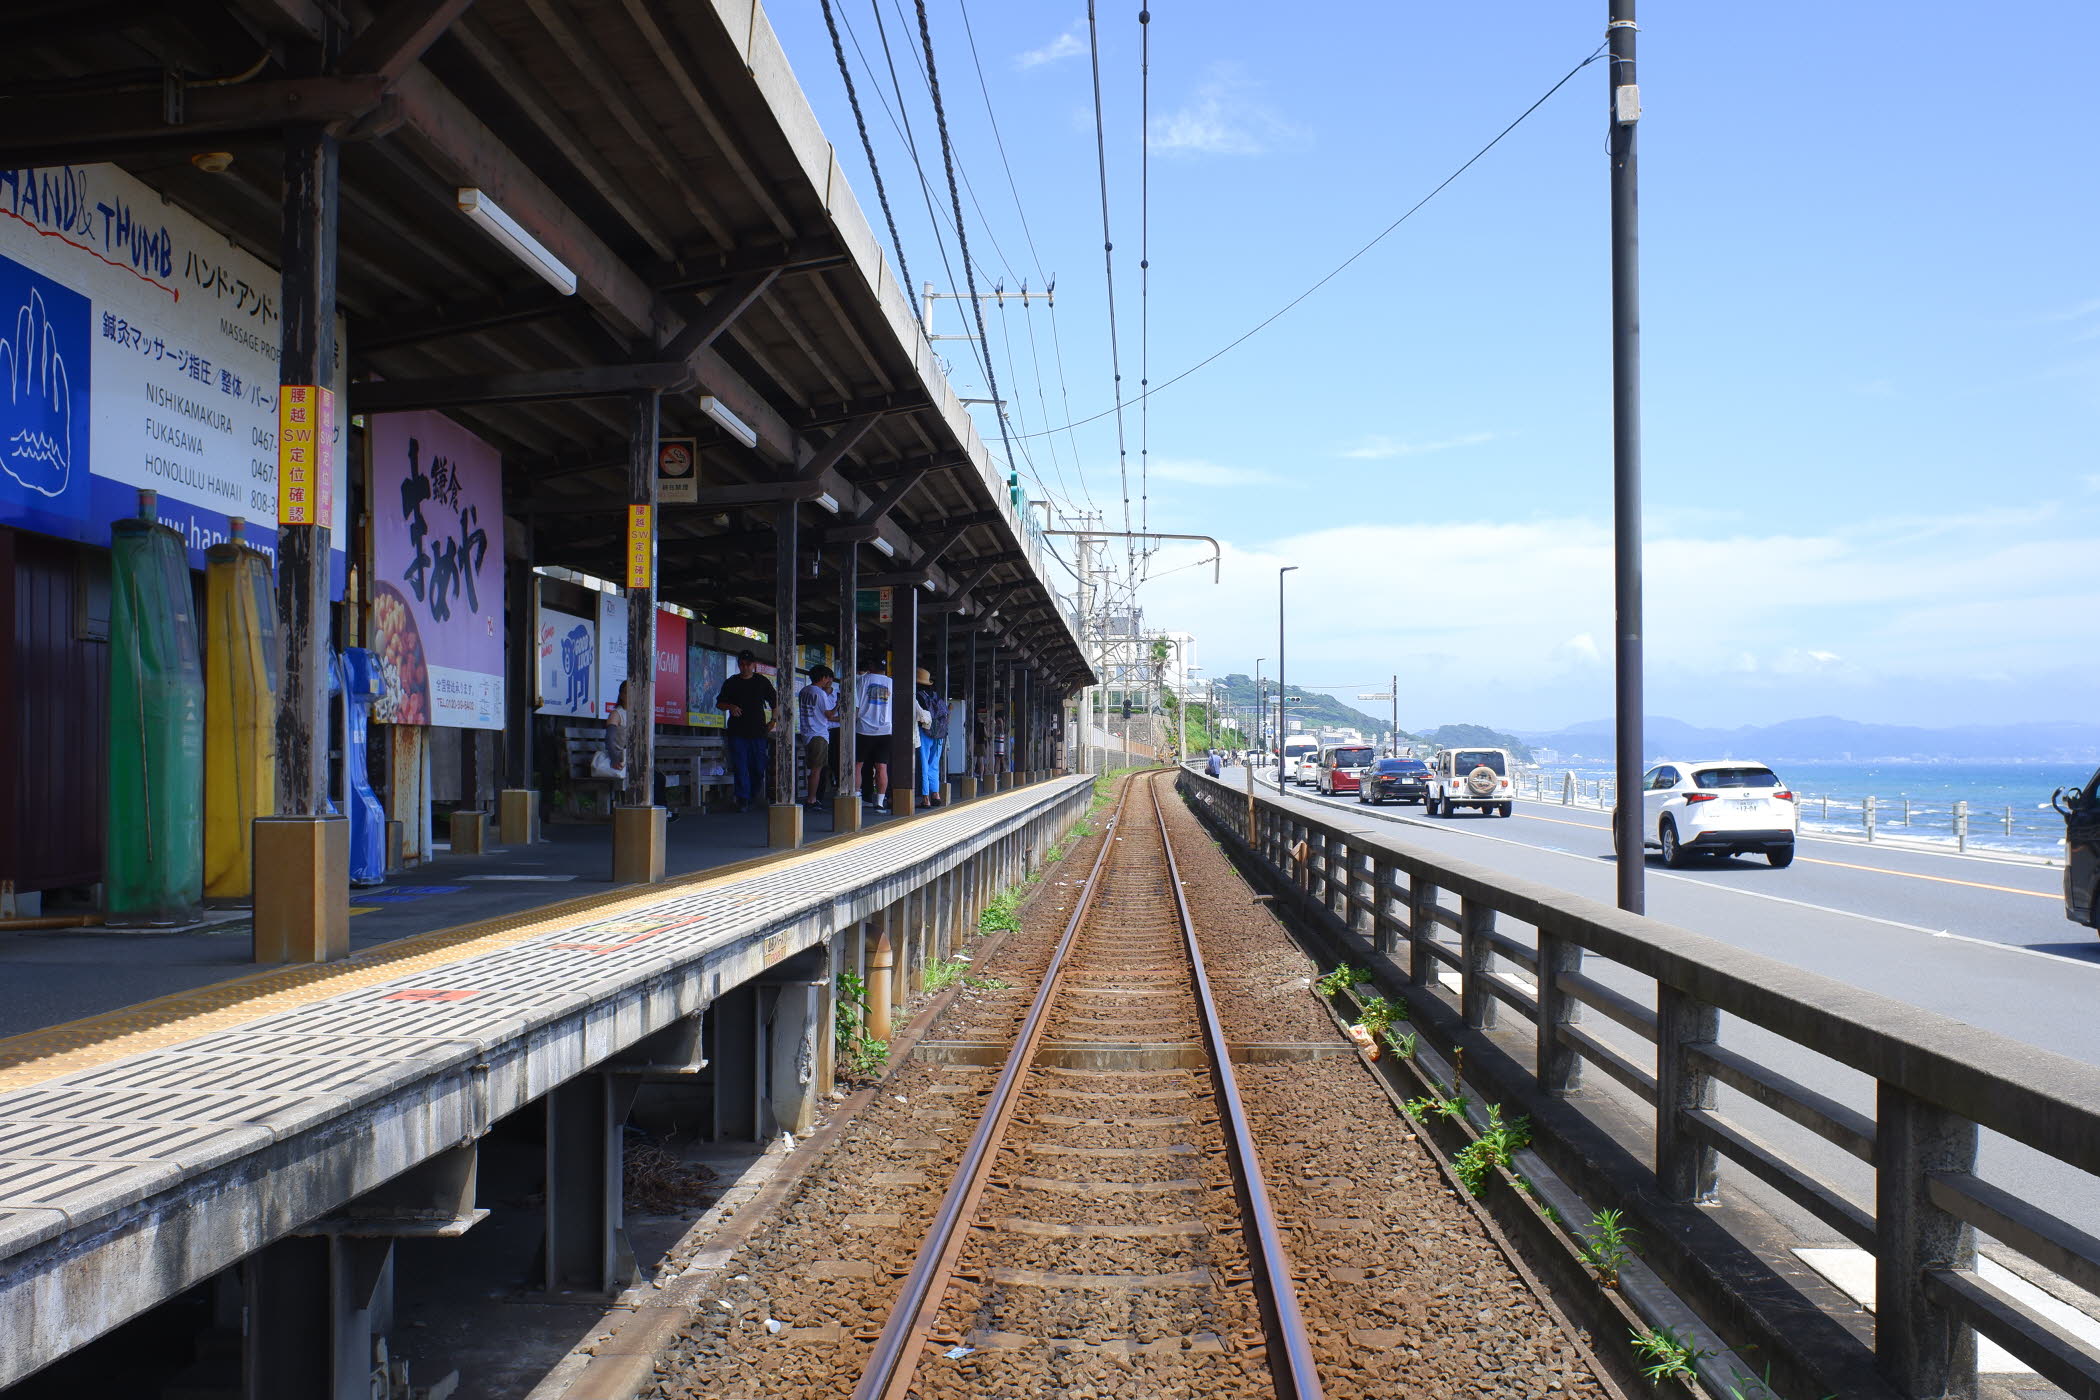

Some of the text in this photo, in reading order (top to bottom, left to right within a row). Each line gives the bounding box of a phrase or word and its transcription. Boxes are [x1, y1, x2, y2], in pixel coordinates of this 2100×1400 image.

[77, 169, 96, 240] &
[97, 195, 172, 278] THUMB
[220, 317, 260, 353] MASSAGE
[146, 382, 233, 435] NISHIKAMAKURA
[145, 418, 204, 457] FUKASAWA
[284, 388, 311, 522] 腰越SW定位確認
[145, 453, 206, 490] HONOLULU
[206, 476, 243, 503] HAWAII
